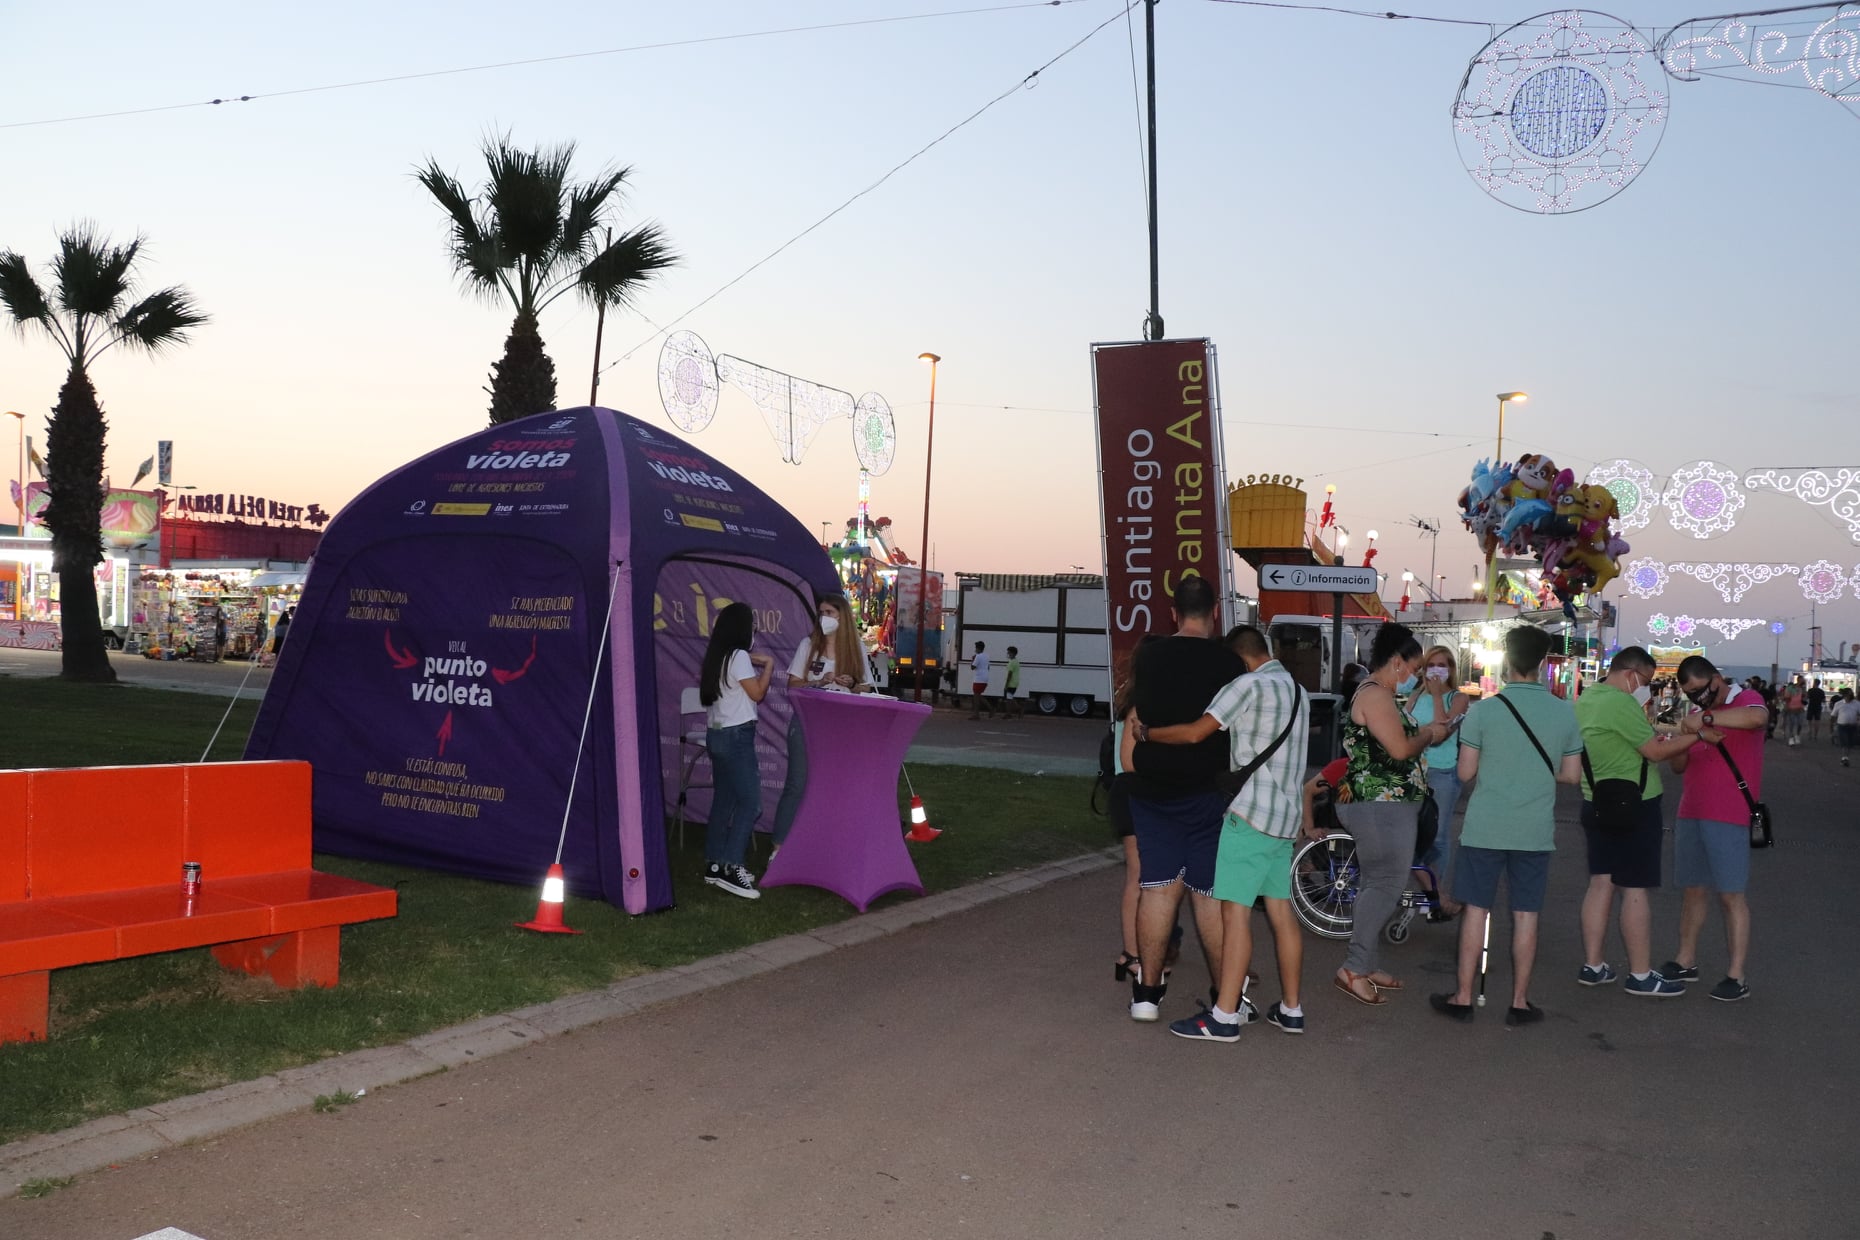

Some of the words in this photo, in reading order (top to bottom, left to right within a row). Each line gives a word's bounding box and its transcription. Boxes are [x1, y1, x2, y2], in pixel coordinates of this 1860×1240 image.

[1166, 359, 1203, 450] Ana
[487, 438, 576, 451] somos
[466, 451, 571, 469] violeta
[647, 460, 733, 493] violeta
[1116, 428, 1162, 632] Santiago
[1309, 573, 1370, 585] Información
[423, 655, 487, 678] punto
[411, 678, 493, 707] violeta
